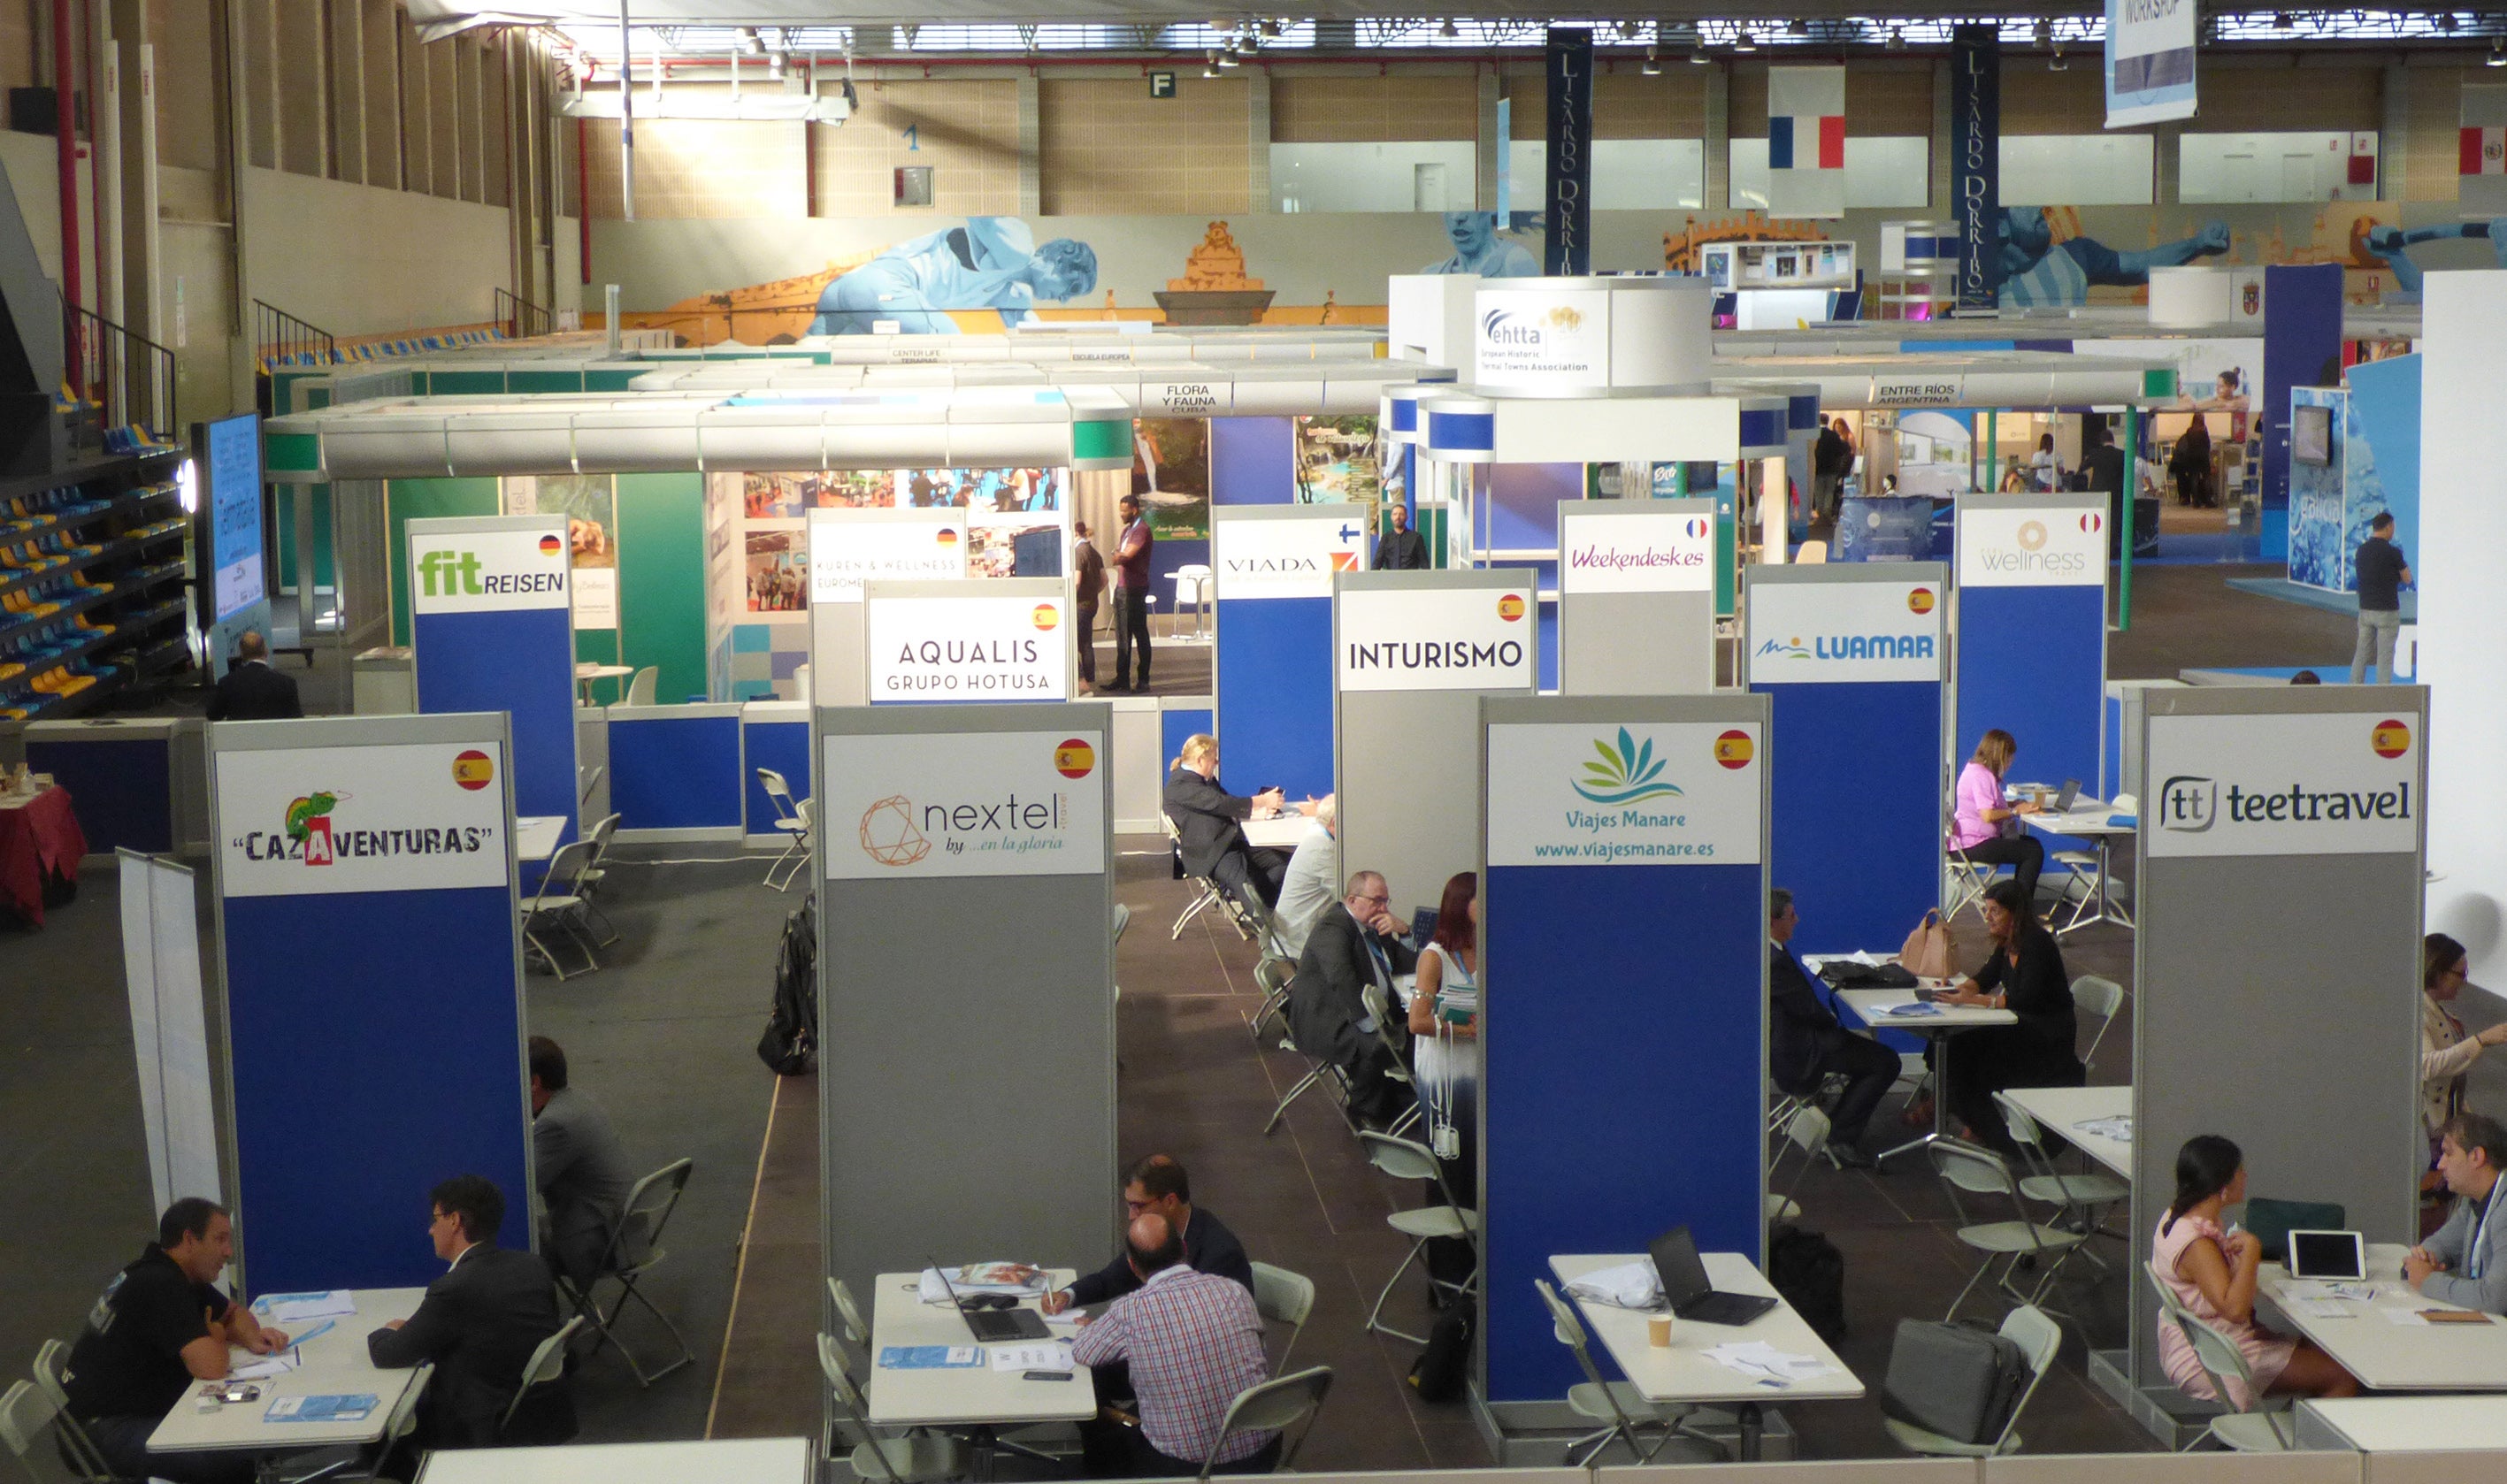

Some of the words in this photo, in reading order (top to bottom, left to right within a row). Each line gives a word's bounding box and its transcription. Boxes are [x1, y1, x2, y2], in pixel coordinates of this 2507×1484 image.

[1154, 74, 1171, 96] F
[1560, 53, 1578, 172] LISARDO
[1966, 50, 1984, 170] LISARDO
[902, 124, 920, 151] 1
[1558, 180, 1579, 276] DORRIB
[1965, 176, 1987, 288] DORRIBO
[1493, 325, 1541, 344] ehtta
[1507, 348, 1540, 358] Historic
[1505, 362, 1529, 371] Towns
[1531, 363, 1589, 371] Association
[1167, 385, 1209, 395] FLORA
[1881, 386, 1922, 396] ENTRE
[1925, 383, 1955, 395] RÍOS
[1174, 397, 1216, 407] FAUNA
[816, 560, 862, 570] KUREN
[885, 559, 956, 570] WELLNESS
[1227, 558, 1317, 572] VIADA
[1572, 544, 1704, 572] Weekendesk.es
[418, 550, 483, 597] fit
[485, 573, 564, 594] REISEN
[818, 578, 863, 588] EUROME
[899, 639, 1038, 665] AQUALIS
[1351, 640, 1522, 669] INTURISMO
[1816, 635, 1934, 660] LUAMAR
[887, 675, 958, 690] GRUPO
[968, 674, 1049, 689] HOTUSA
[924, 792, 1058, 831] nextel
[2227, 781, 2411, 822] teetravel
[1566, 810, 1617, 833] Viajes
[1622, 810, 1686, 828] Manare
[946, 837, 964, 855] by
[1001, 836, 1016, 851] la
[1017, 835, 1063, 853] gloria
[1535, 841, 1714, 863] www.viajesmanare.es
